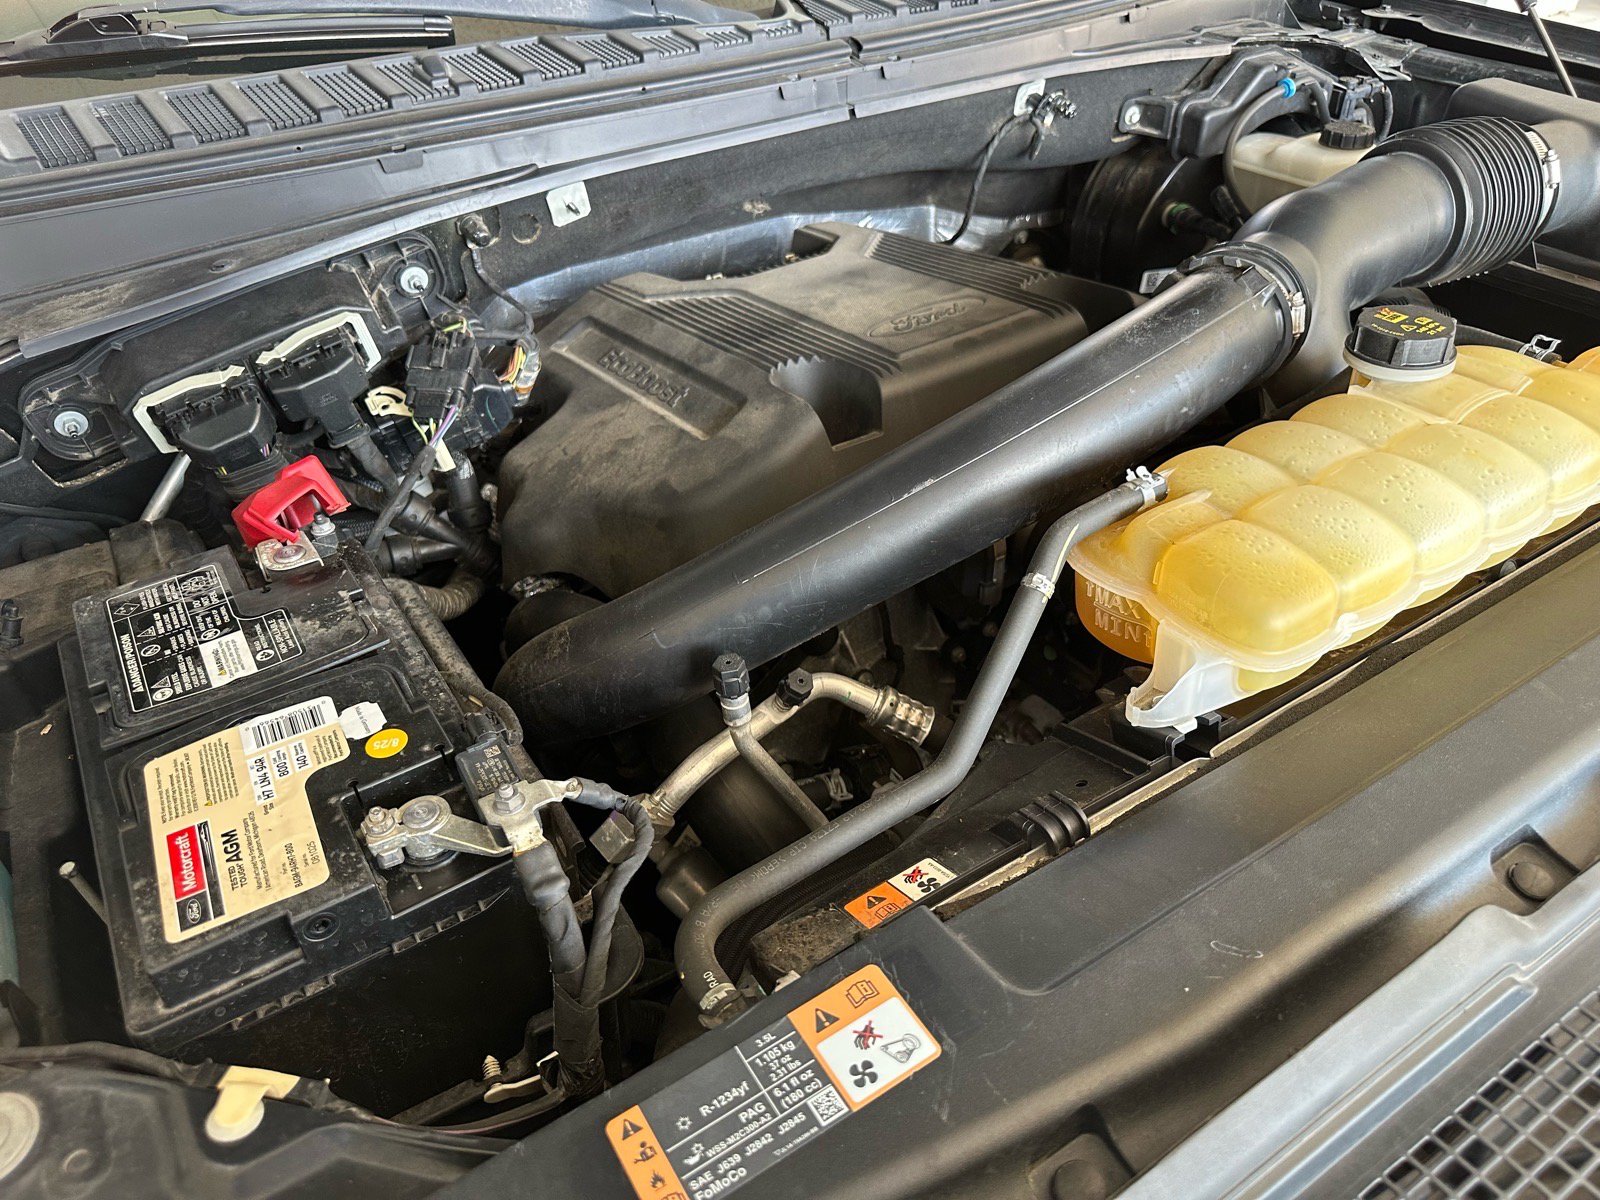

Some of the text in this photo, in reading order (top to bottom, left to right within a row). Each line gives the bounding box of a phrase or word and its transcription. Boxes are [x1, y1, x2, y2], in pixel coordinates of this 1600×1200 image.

[597, 348, 690, 408] EcoBoost
[1094, 584, 1141, 619] MAX
[268, 619, 287, 653] NON-SPILLABLE
[1094, 608, 1140, 643] MIN
[120, 634, 141, 687] DANGER/POISON
[373, 737, 398, 748] 8/25
[276, 761, 289, 777] 800
[296, 755, 308, 768] 140
[254, 756, 273, 800] H7 LN4 94R
[221, 829, 242, 862] AGM
[306, 840, 320, 864] 081025
[176, 833, 195, 891] Motorcraft
[227, 865, 238, 890] TESTED
[187, 901, 199, 921] Ford
[703, 971, 718, 988] RAD
[755, 1032, 776, 1047] 3.5L
[755, 1040, 795, 1066] 1.105 kg
[769, 1054, 791, 1070] 37 oz
[769, 1059, 801, 1081] 2.31 lbs
[773, 1069, 814, 1096] 6.1 fl oz
[781, 1077, 822, 1108] (180 cc)
[699, 1081, 748, 1115] R-1234yf
[738, 1102, 765, 1122] PAG
[689, 1112, 805, 1189] SAE J639 J2842 J2845
[706, 1113, 771, 1160] WSS-M2C300-A2
[694, 1167, 746, 1199] FoMoCo
